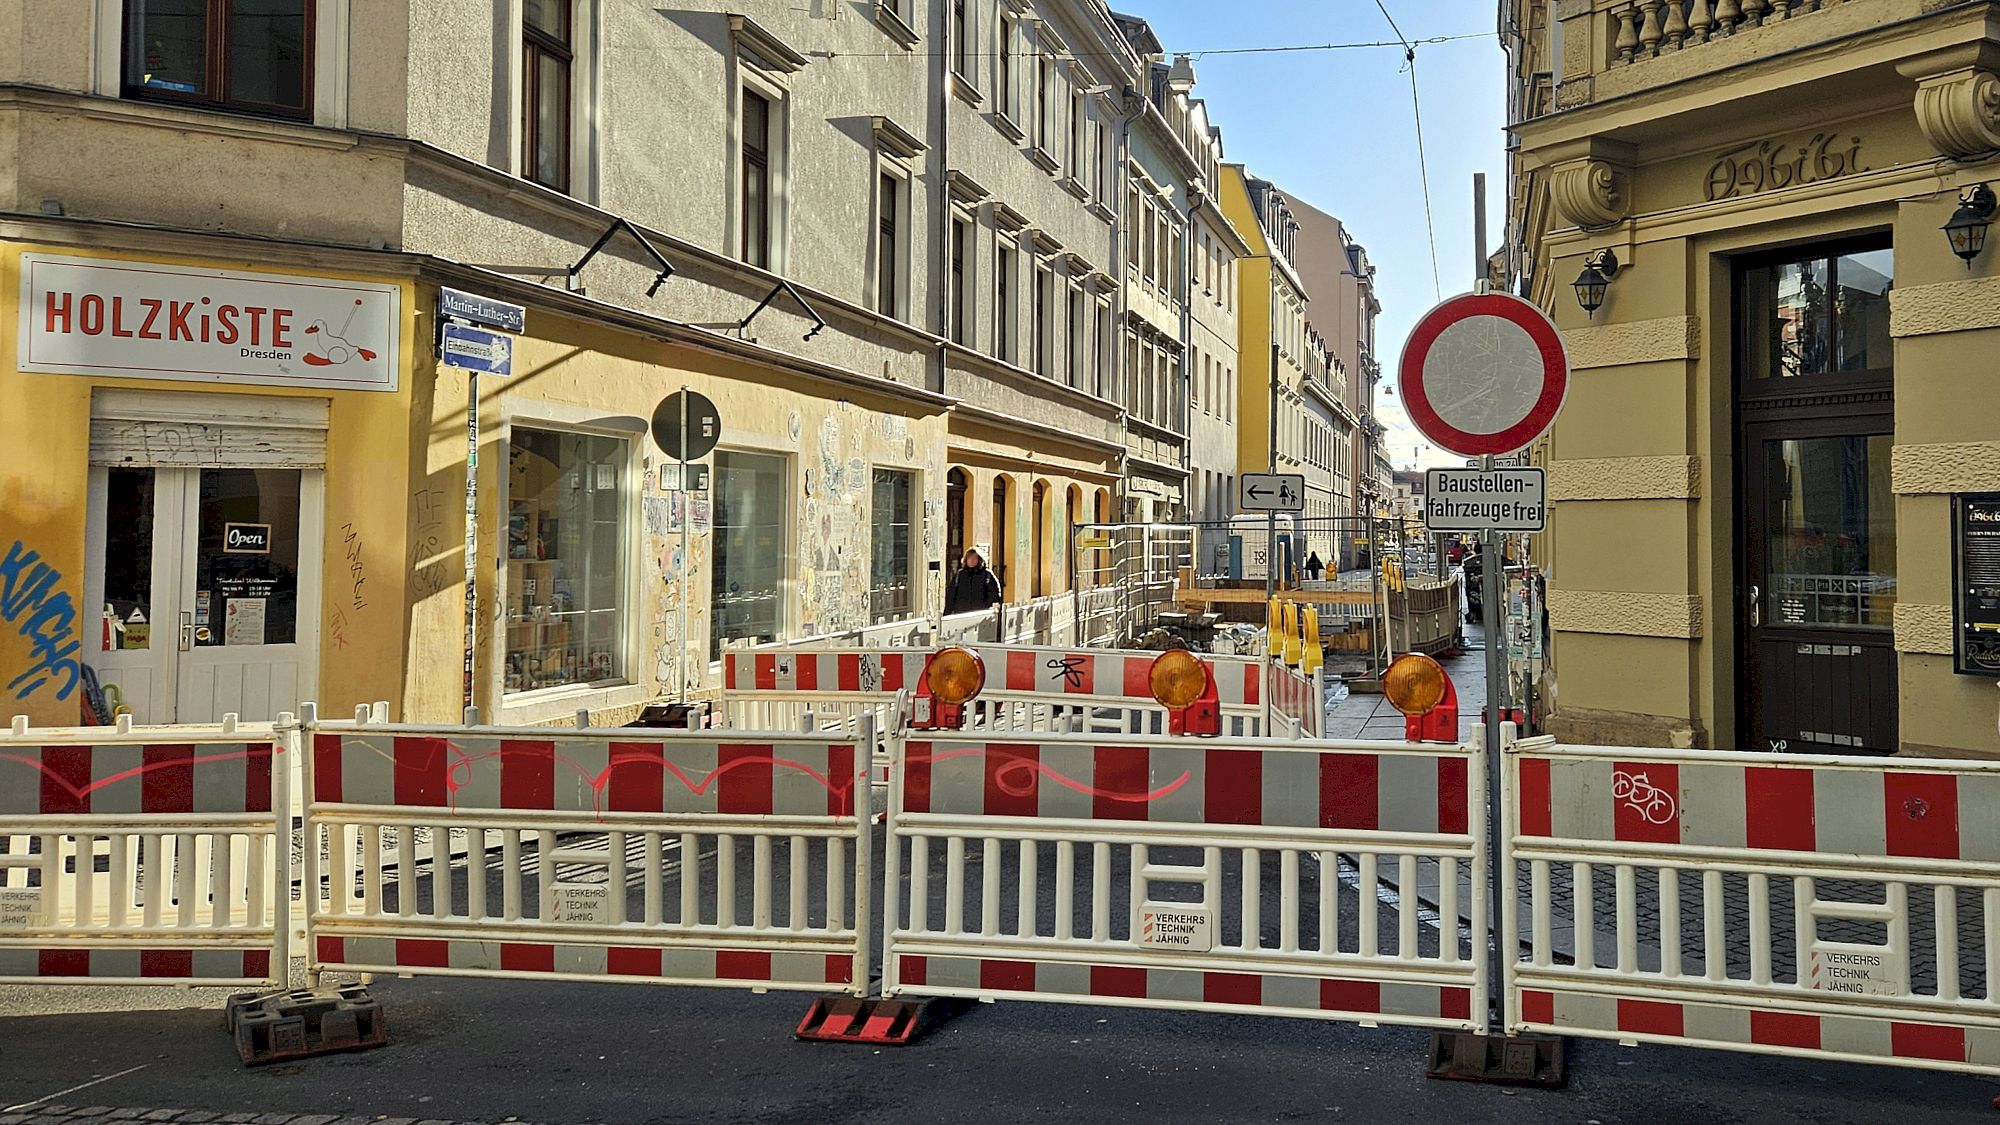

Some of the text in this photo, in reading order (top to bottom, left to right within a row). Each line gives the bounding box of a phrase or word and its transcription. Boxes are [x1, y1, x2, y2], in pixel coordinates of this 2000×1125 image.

[46, 291, 293, 348] HOLZKiSTE
[240, 348, 292, 361] Dresden
[1438, 473, 1534, 493] Baustellen-
[1428, 498, 1542, 523] fahrzeuge frei
[228, 529, 266, 547] Open
[1, 892, 40, 901] VERKEHRS
[565, 889, 606, 898] VERKEHRS
[1, 903, 32, 913] TECHNIK
[565, 900, 598, 910] TECHNIK
[565, 912, 593, 921] JÄHNIG
[1156, 913, 1205, 924] VERKEHRS
[1156, 923, 1195, 934] TECHNIK
[1156, 933, 1190, 945] JÄHNIG
[1826, 952, 1880, 966] VERKEHRS
[1827, 966, 1870, 980] TECHNIK
[1827, 979, 1863, 994] JÄHNIG
